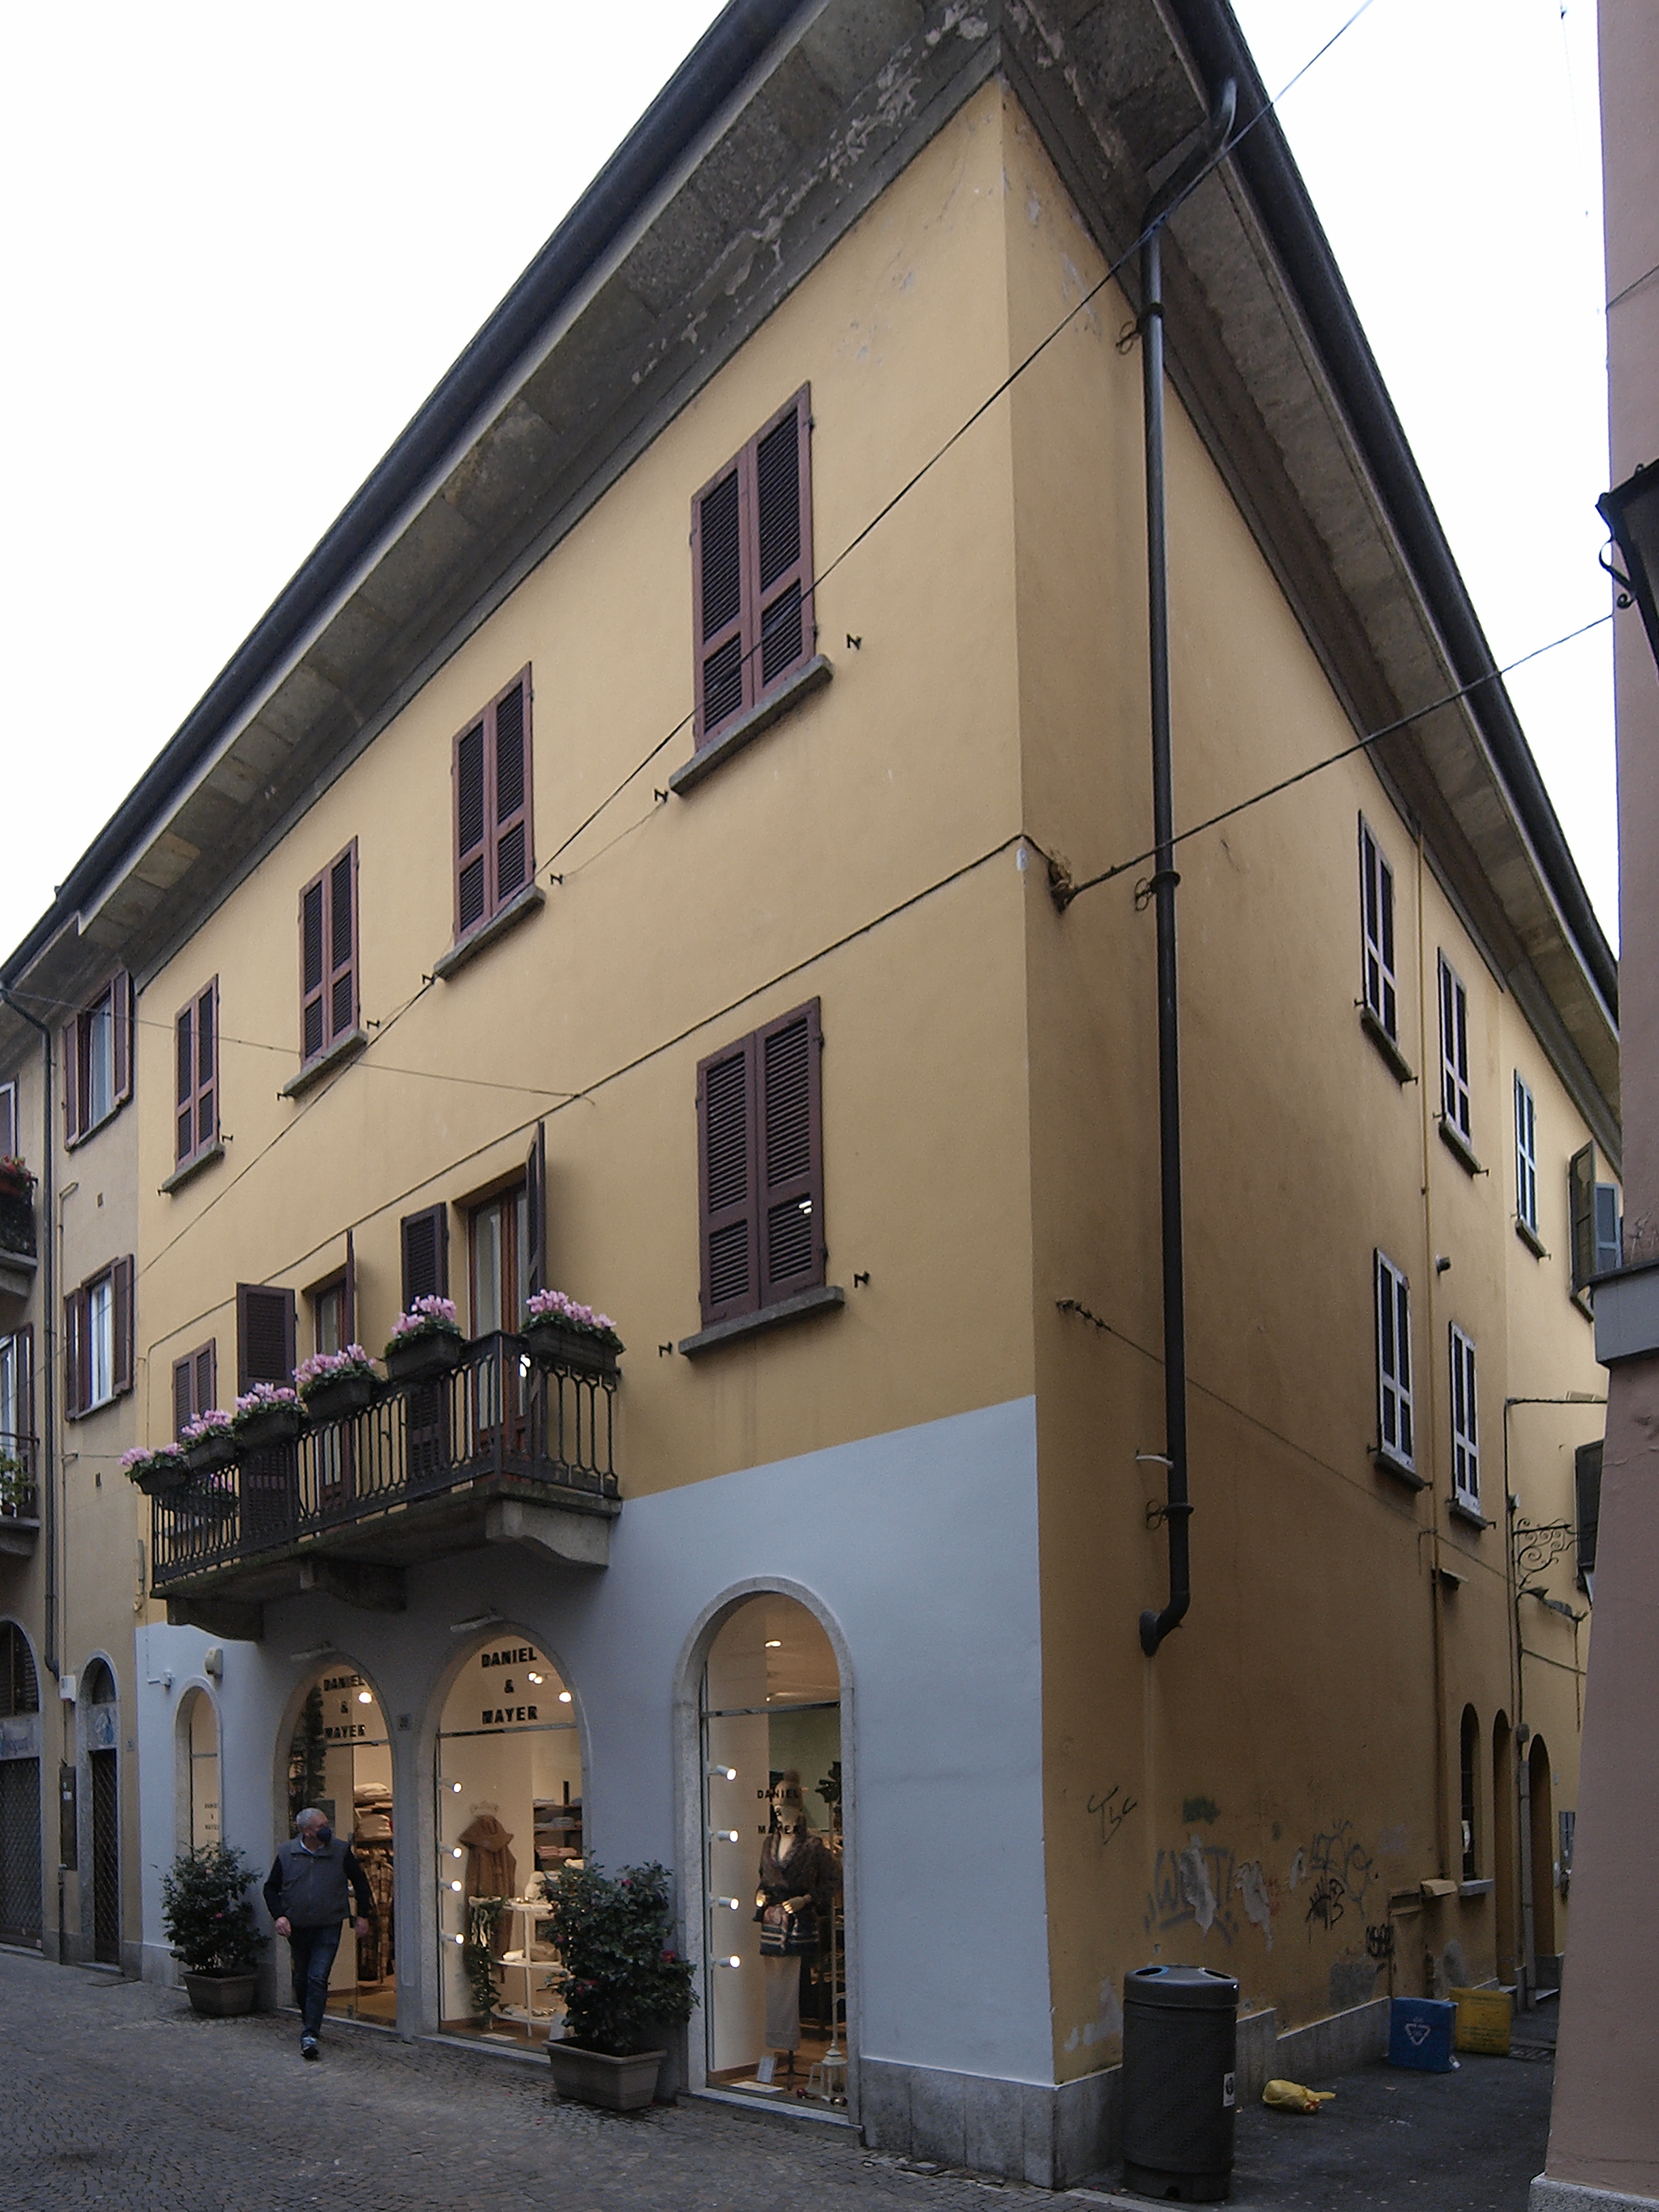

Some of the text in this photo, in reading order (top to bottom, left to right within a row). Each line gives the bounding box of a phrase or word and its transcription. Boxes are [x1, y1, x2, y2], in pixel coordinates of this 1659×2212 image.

[481, 1647, 537, 1667] DANIEL
[504, 1679, 514, 1693] &
[482, 1706, 538, 1724] MAYER
